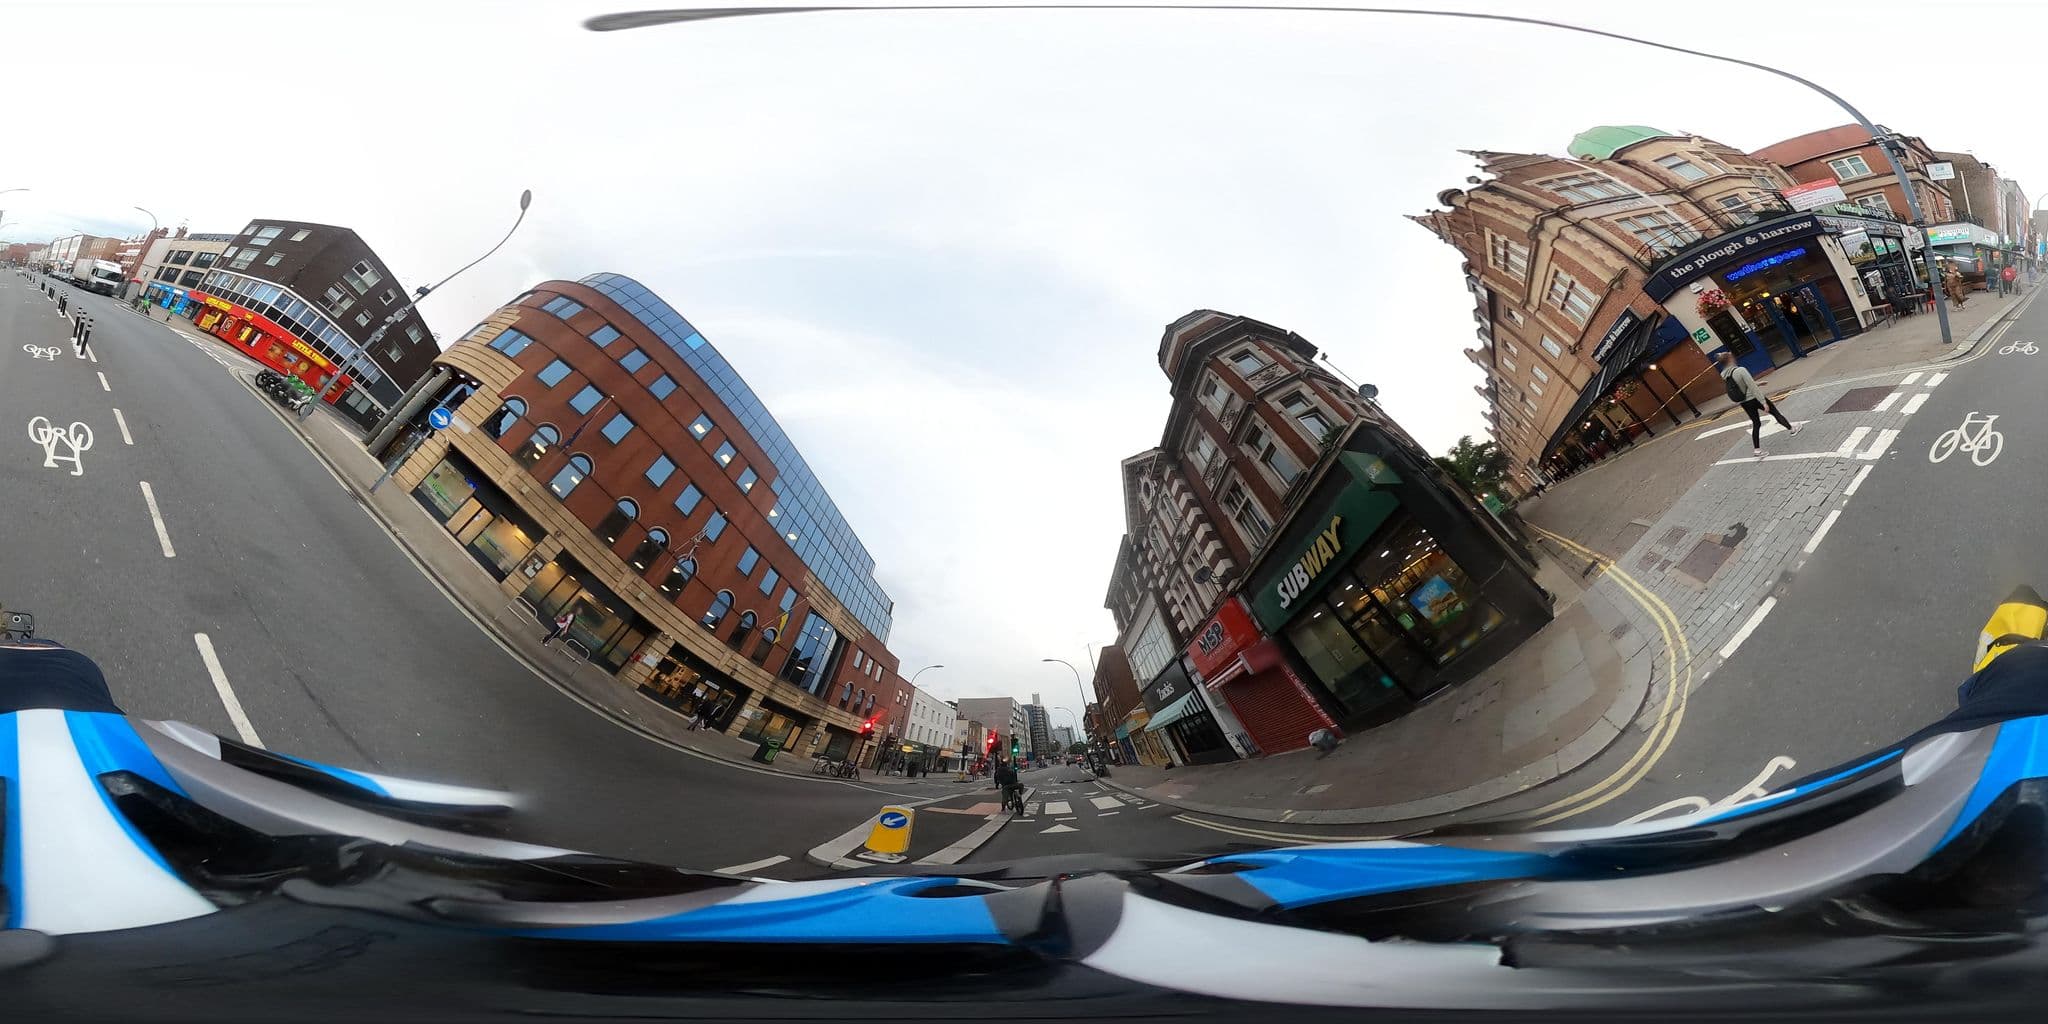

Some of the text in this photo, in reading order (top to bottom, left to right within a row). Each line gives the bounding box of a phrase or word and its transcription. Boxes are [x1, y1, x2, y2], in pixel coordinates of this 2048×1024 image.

[1670, 264, 1694, 279] the
[1694, 241, 1745, 269] plough
[1745, 235, 1759, 245] &
[1760, 220, 1813, 240] harrow
[1277, 515, 1341, 609] SUBWAY
[1198, 620, 1224, 656] MSP
